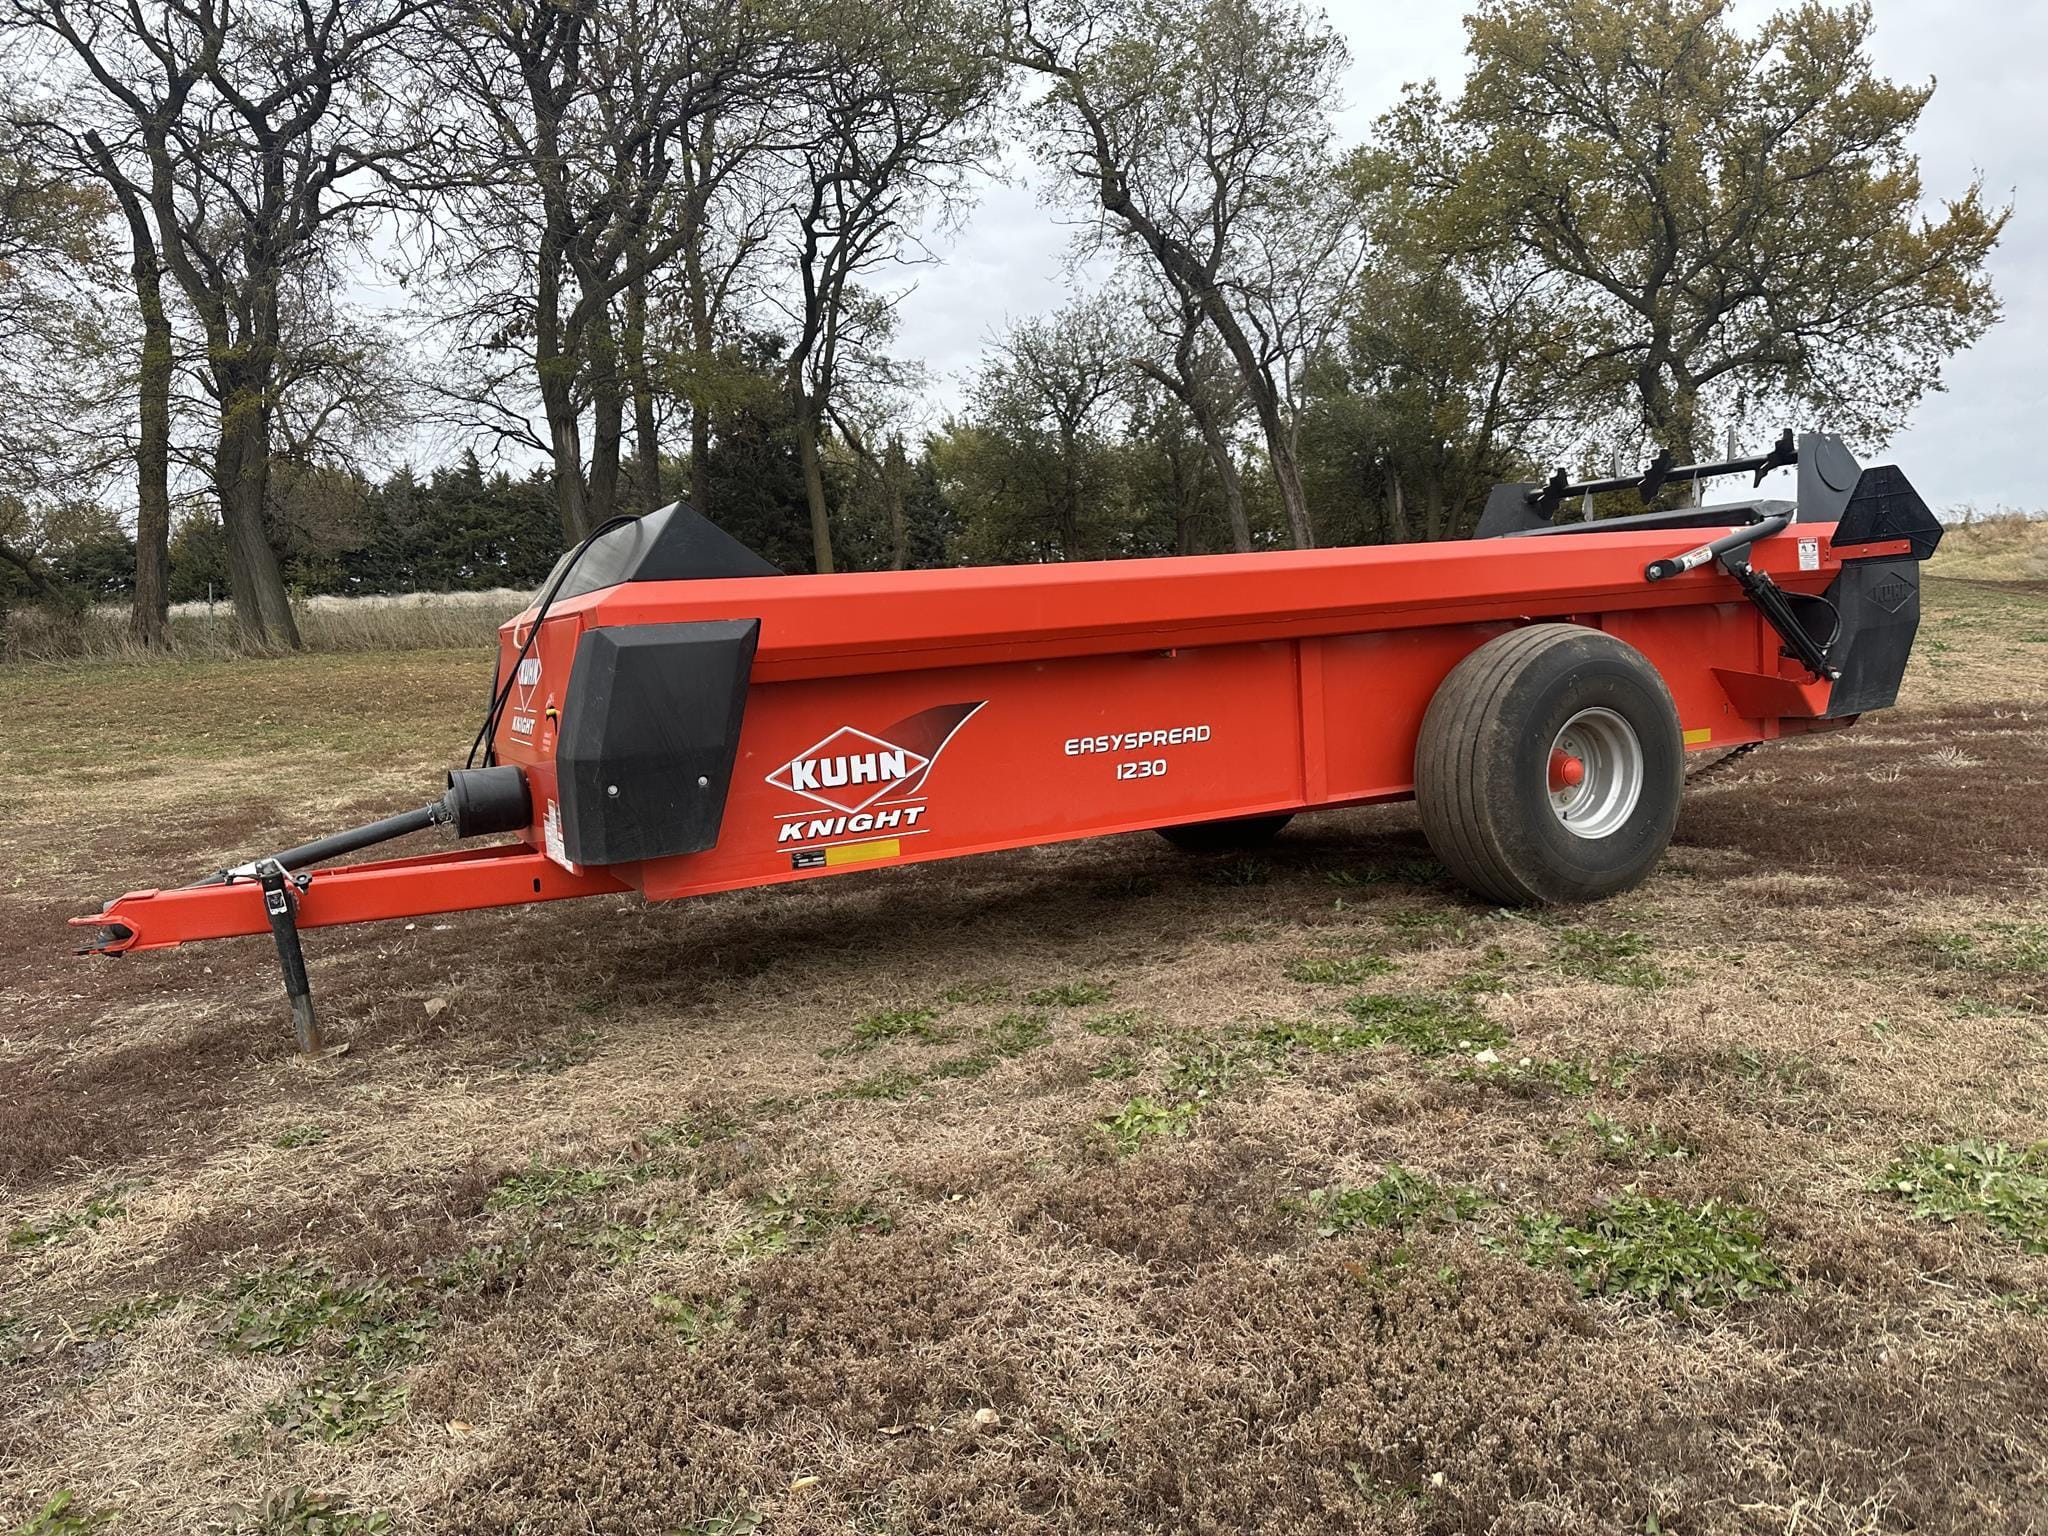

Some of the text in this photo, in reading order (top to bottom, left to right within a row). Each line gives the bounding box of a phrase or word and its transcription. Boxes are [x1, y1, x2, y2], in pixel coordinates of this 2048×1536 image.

[512, 716, 535, 735] KNIGHT
[1064, 725, 1211, 755] EASYSPREAD
[790, 750, 906, 791] KUHN
[1116, 759, 1167, 780] 1230
[777, 806, 926, 843] KNIGHT
